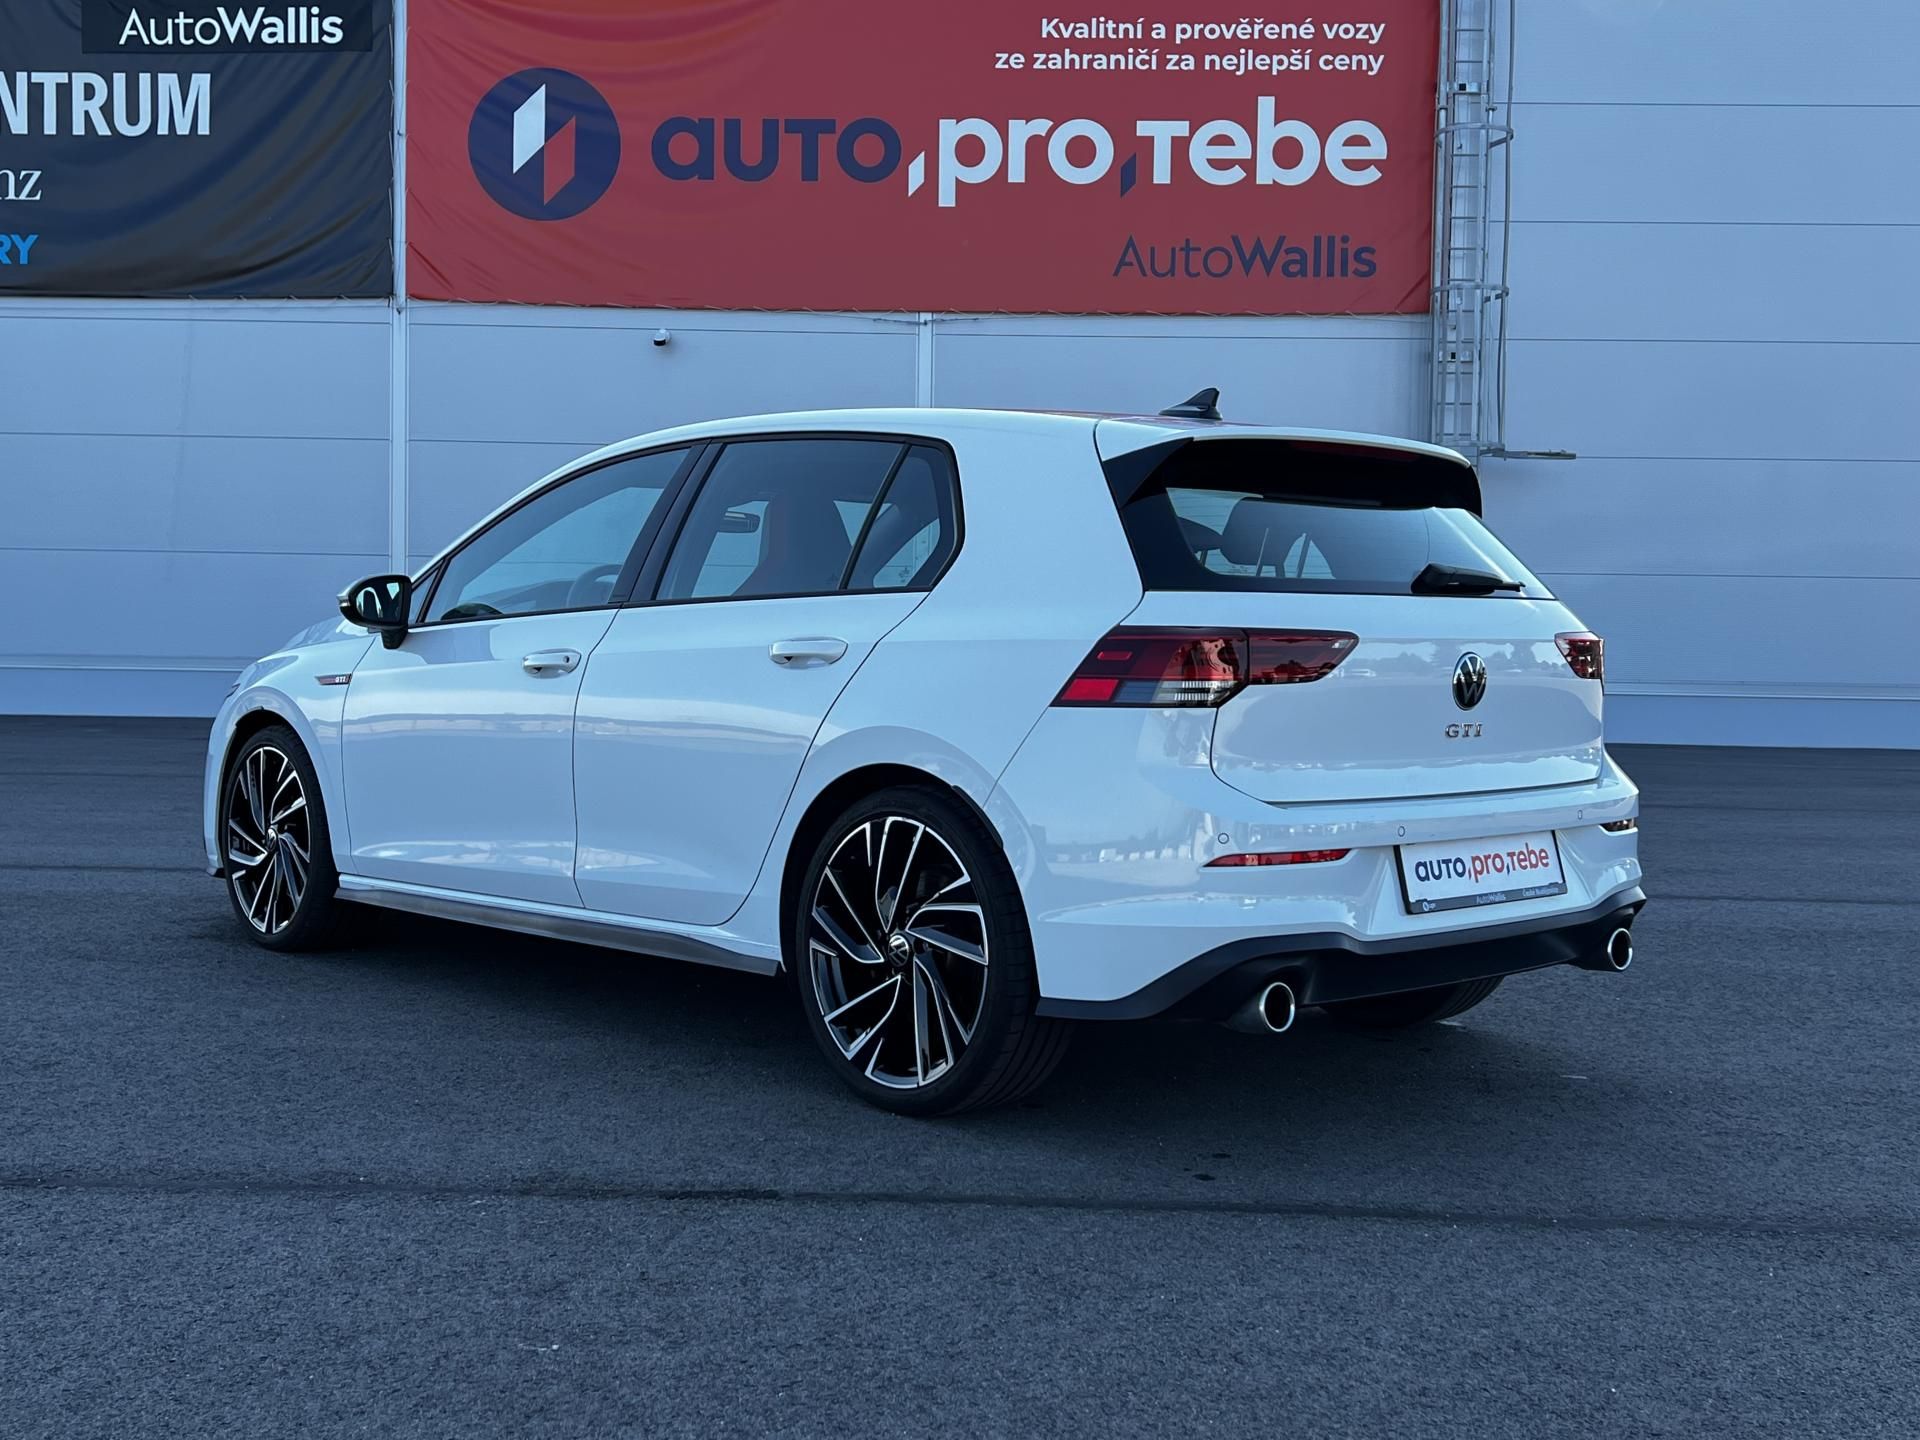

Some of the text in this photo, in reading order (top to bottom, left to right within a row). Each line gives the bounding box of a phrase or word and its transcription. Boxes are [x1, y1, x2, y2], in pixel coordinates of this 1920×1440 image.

[118, 6, 344, 46] AutoWallis
[1041, 17, 1386, 44] Kvalitní a prověřené vozy
[994, 49, 1385, 76] ze zahraničí za nejlepší ceny
[1113, 234, 1377, 278] AutoWallis
[1445, 722, 1483, 738] GTI
